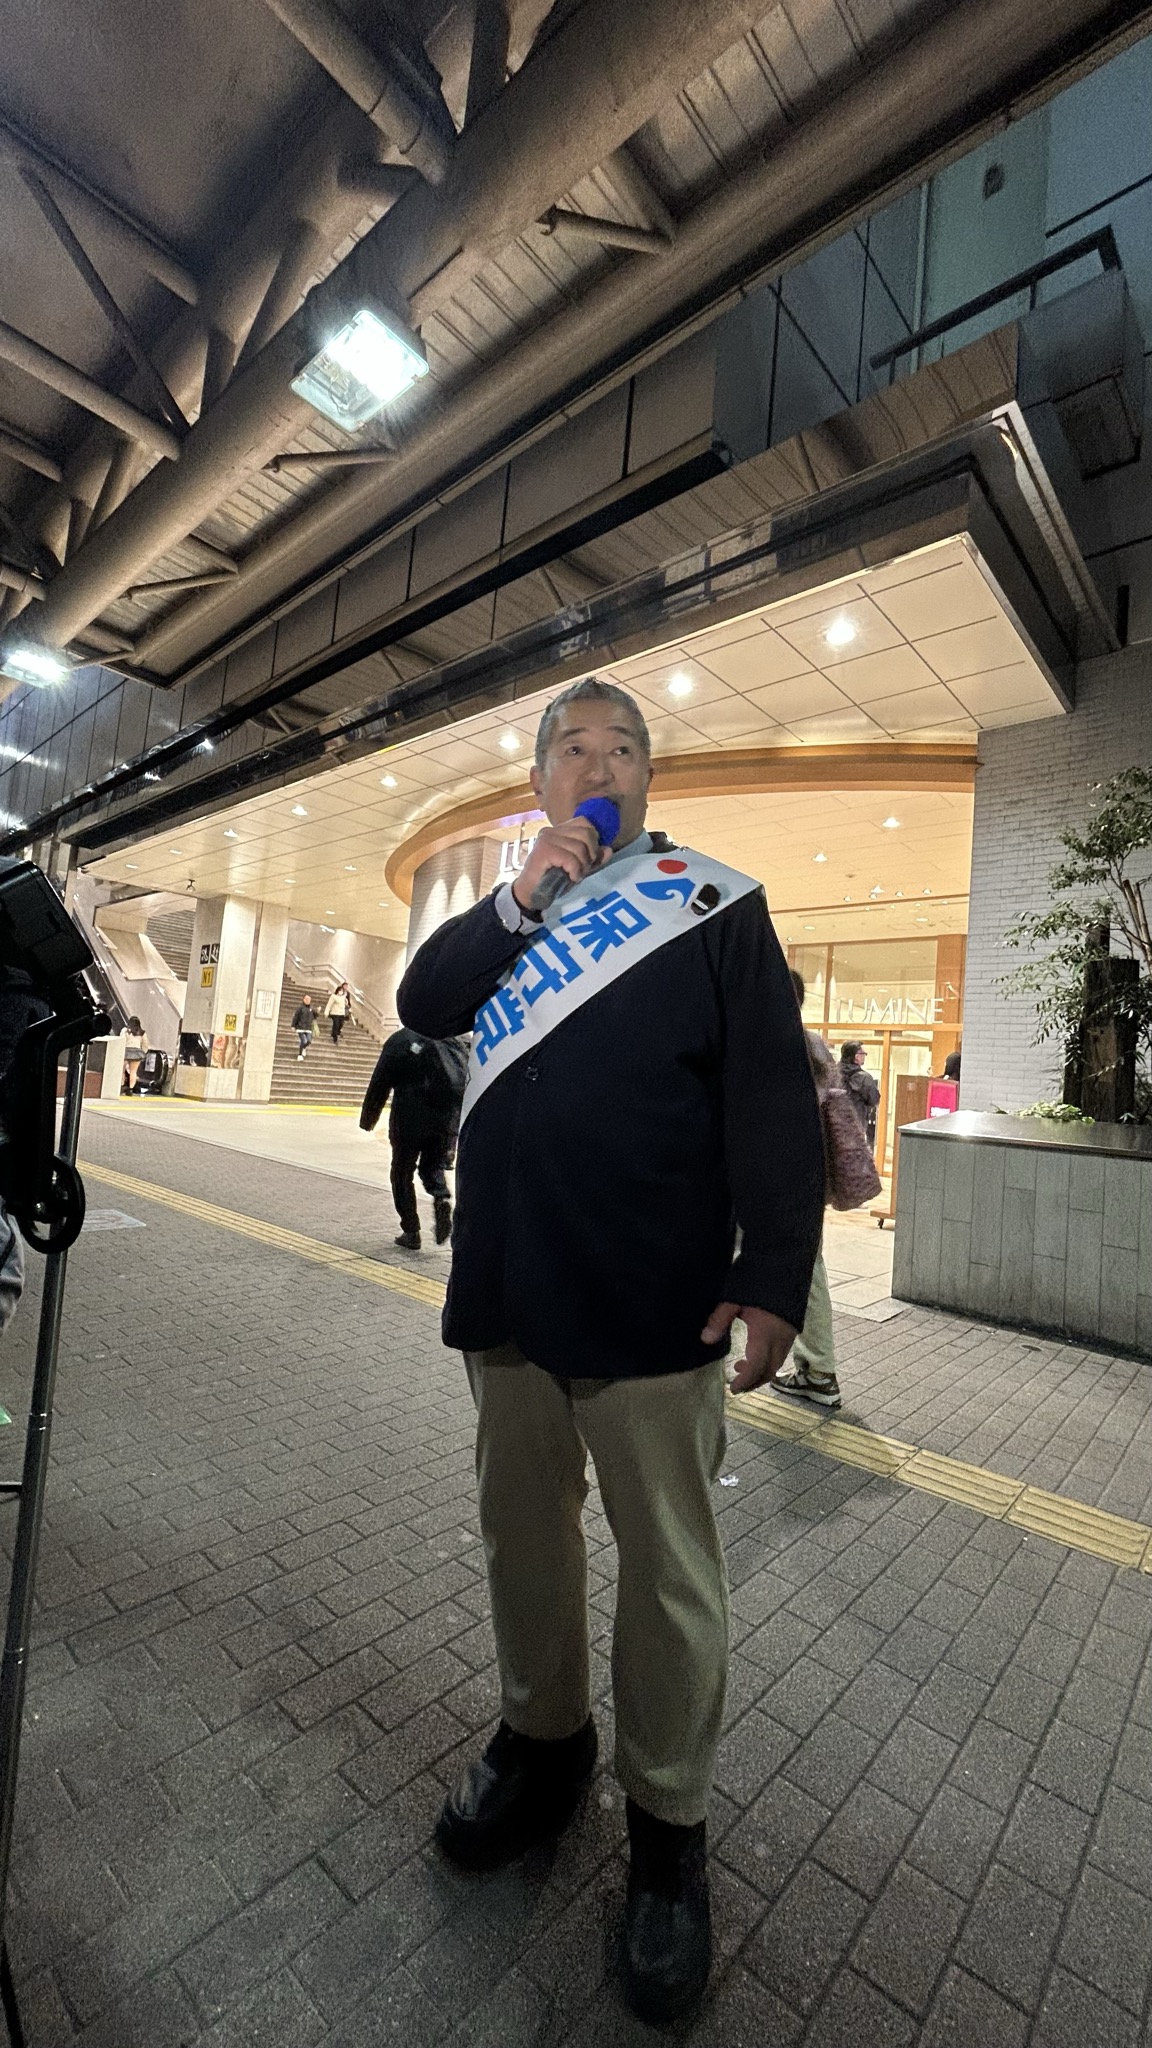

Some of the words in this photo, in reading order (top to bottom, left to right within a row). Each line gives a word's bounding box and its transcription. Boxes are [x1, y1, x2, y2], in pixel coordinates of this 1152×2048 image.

[473, 890, 652, 1067] 保守党
[835, 997, 944, 1025] LUMINE
